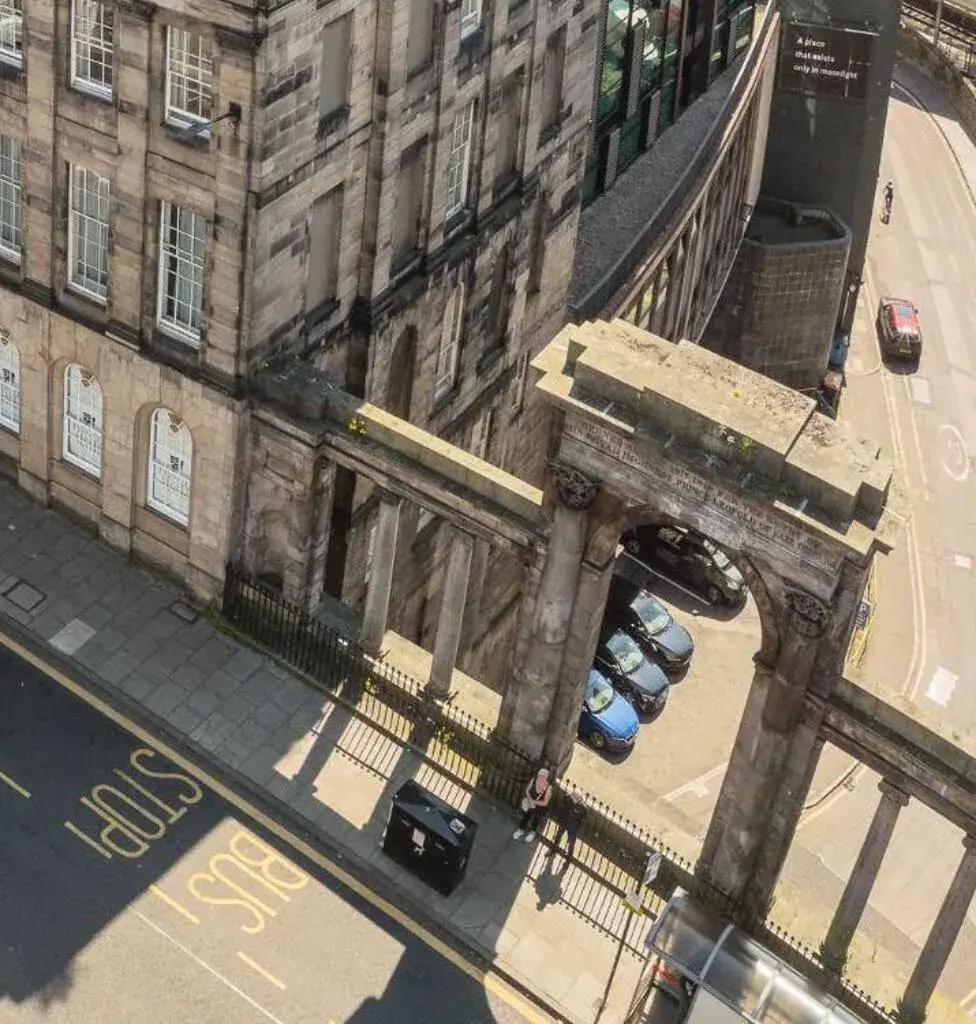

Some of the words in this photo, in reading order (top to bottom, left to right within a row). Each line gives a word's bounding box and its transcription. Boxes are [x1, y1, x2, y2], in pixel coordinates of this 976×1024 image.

[804, 38, 825, 48] place
[795, 51, 811, 59] that
[793, 64, 810, 74] only
[81, 748, 204, 858] STOP
[188, 830, 310, 935] BUS
